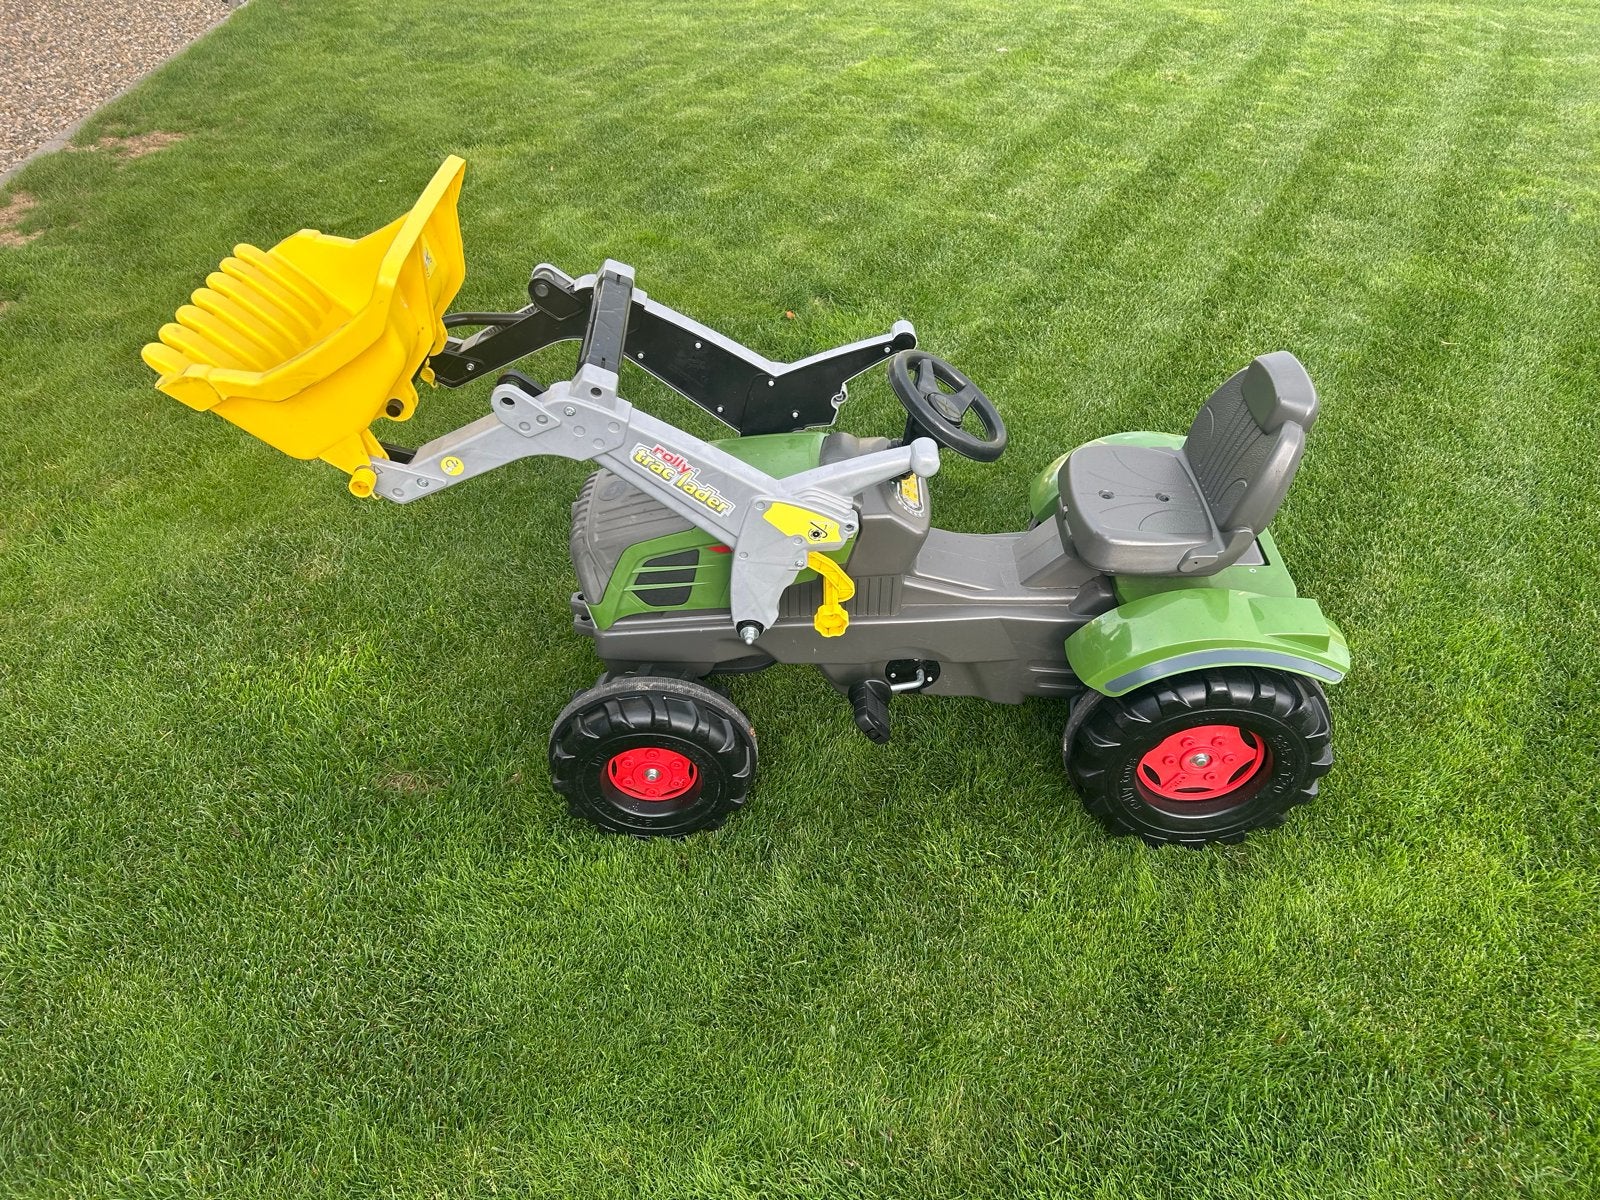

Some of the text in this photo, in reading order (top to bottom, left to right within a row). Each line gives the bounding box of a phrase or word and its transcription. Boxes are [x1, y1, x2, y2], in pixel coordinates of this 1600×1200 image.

[632, 448, 730, 513] trac lader
[651, 445, 692, 474] rolly
